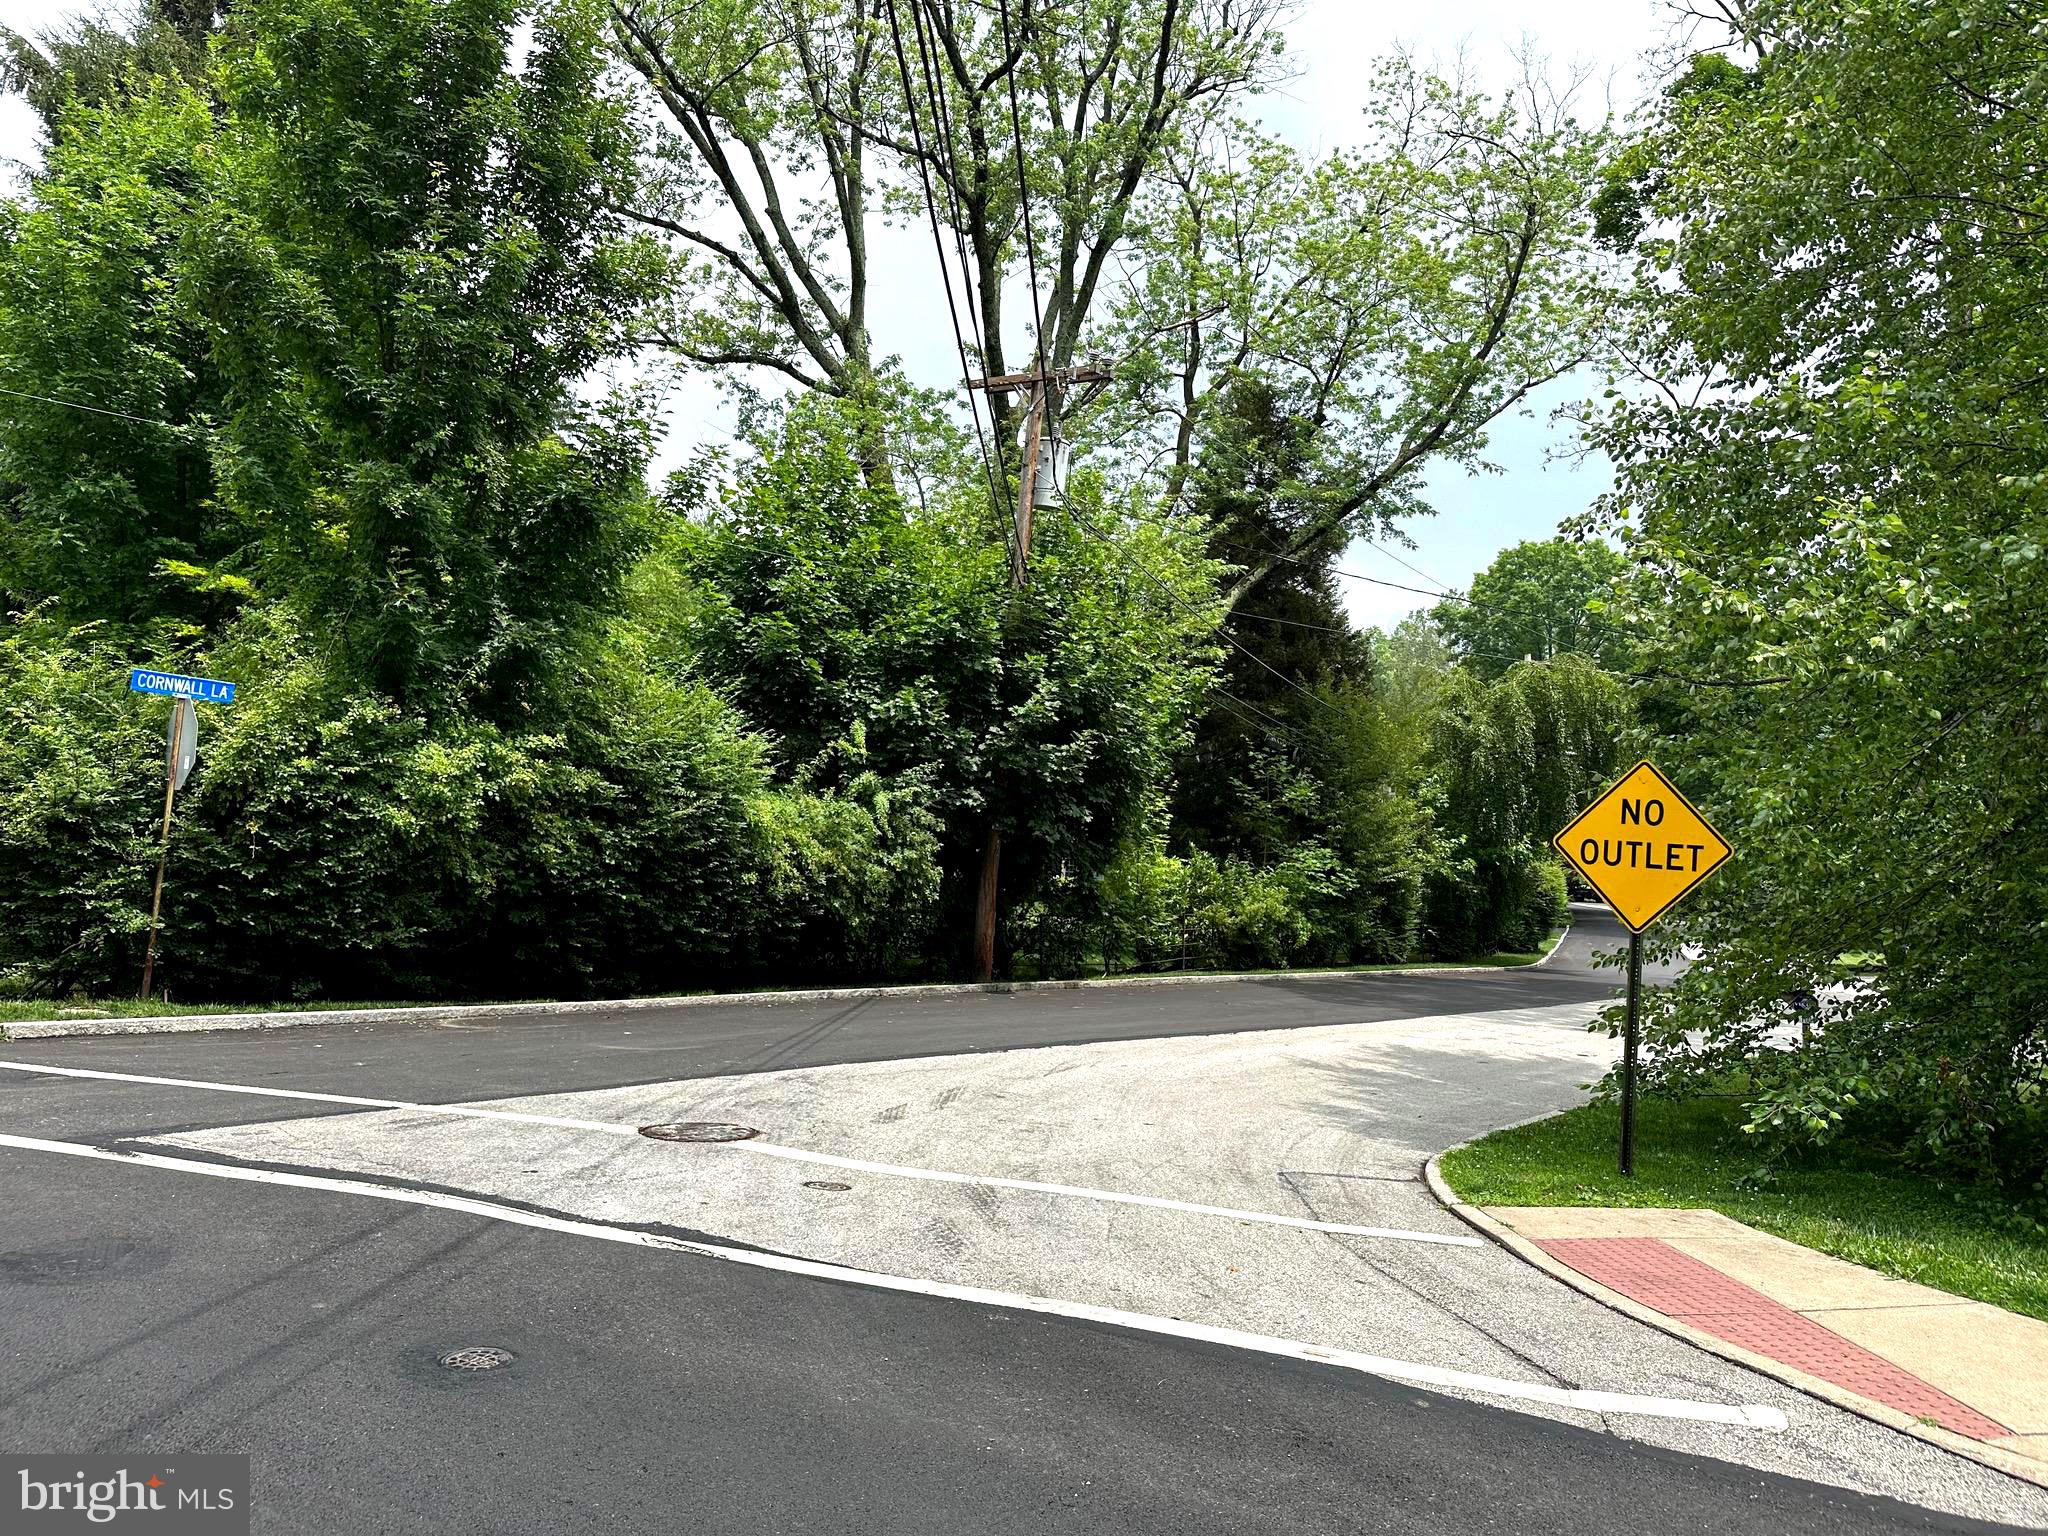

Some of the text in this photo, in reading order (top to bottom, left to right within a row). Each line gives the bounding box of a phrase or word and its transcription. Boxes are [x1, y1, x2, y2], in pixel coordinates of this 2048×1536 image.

[137, 673, 228, 699] CORNWALL LA
[1620, 798, 1665, 826] NO
[1580, 838, 1705, 872] OUTLET
